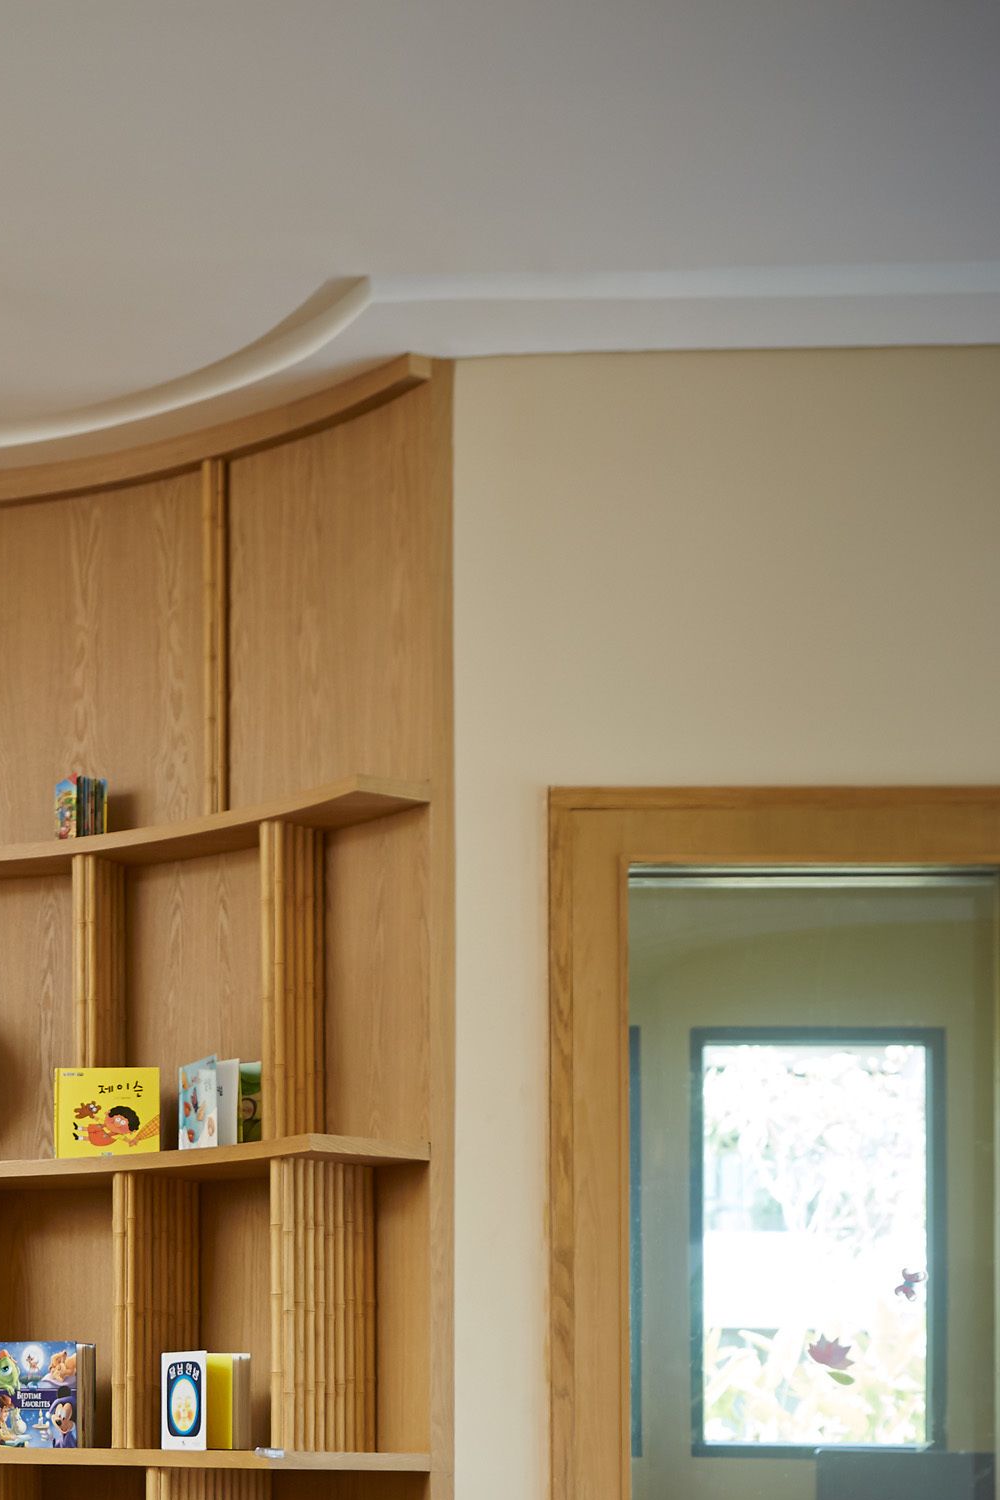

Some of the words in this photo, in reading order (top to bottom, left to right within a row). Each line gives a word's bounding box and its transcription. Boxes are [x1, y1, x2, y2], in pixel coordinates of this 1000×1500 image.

[98, 1080, 144, 1098] 제이슨
[16, 1390, 42, 1400] BEDTIME
[21, 1399, 51, 1408] FAVORITES
